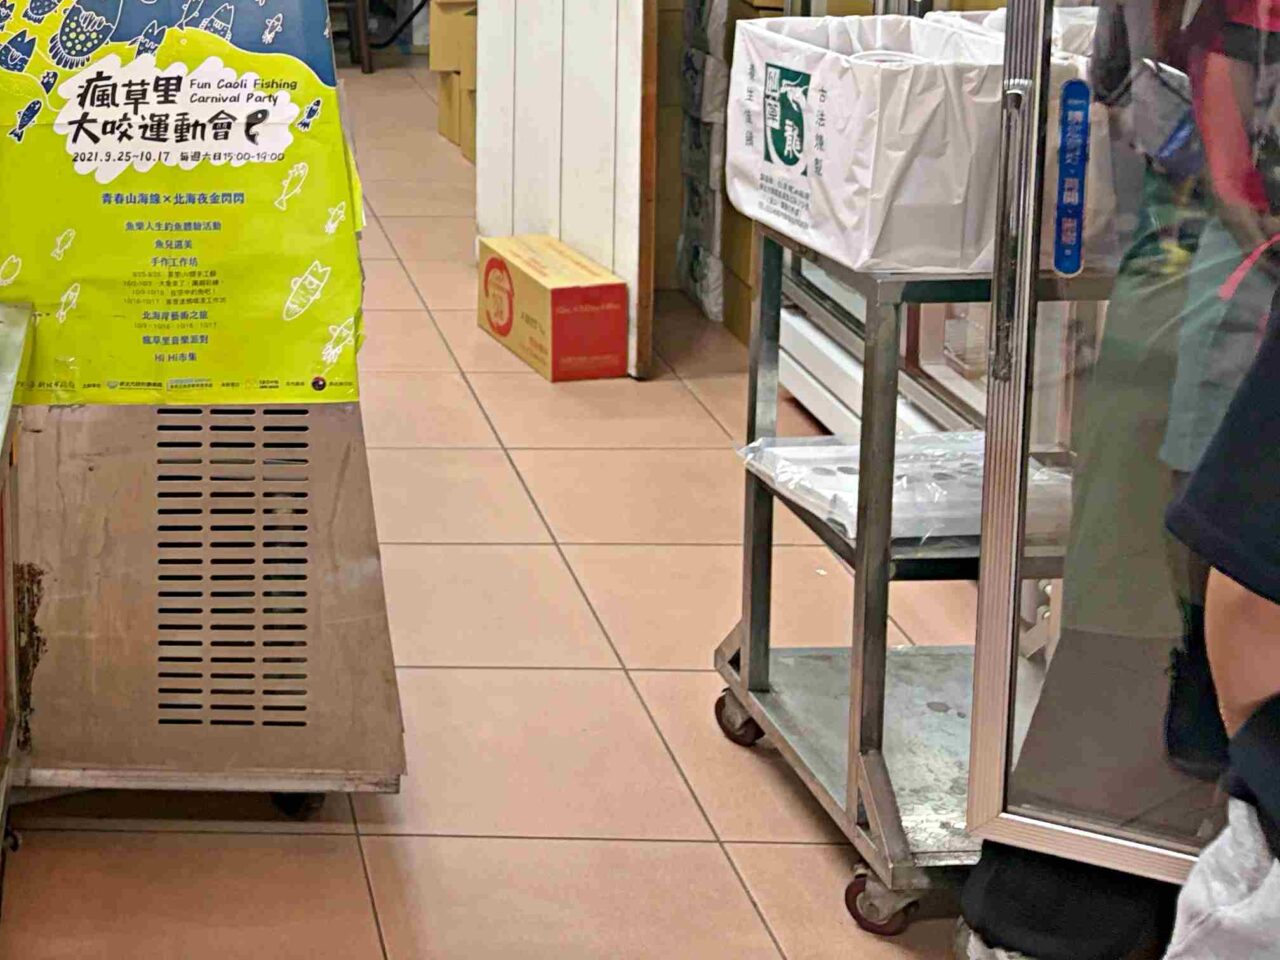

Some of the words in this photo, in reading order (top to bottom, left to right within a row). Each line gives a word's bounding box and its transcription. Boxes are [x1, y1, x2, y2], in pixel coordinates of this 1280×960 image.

[77, 70, 184, 115] 瘋草里
[190, 78, 211, 89] Fun
[219, 78, 248, 89] Caoli
[253, 78, 298, 91] Fishing
[190, 93, 240, 103] Carnival
[246, 93, 279, 106] Party
[68, 109, 238, 145] 大咬運動會
